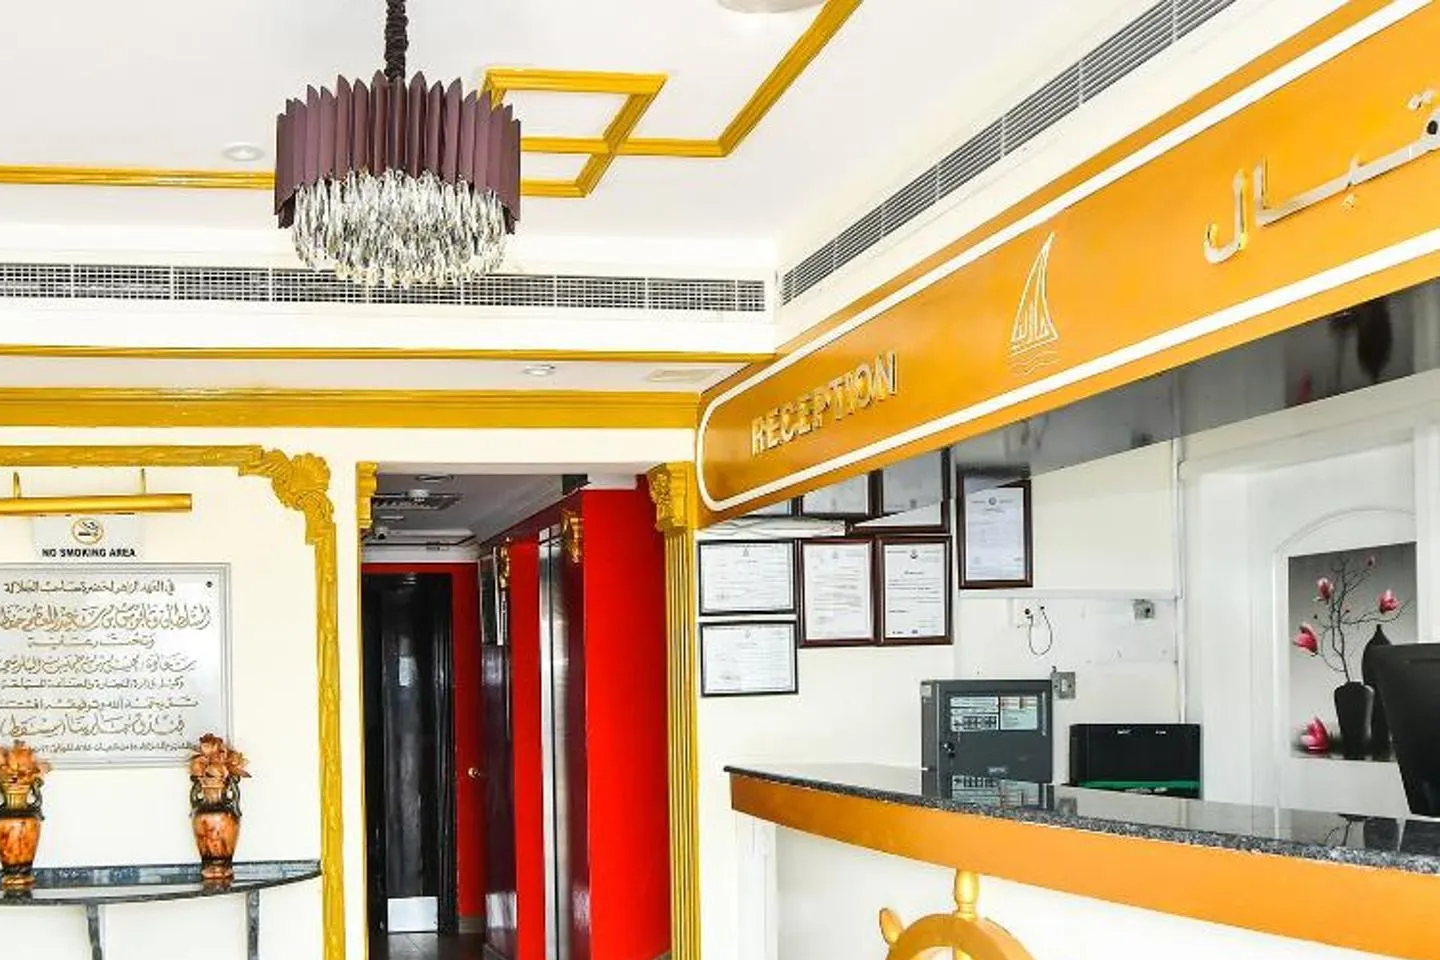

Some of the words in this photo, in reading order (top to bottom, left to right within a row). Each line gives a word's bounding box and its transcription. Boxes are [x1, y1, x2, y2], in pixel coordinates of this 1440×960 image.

[751, 350, 897, 456] RECEPTION
[42, 548, 57, 557] NO
[60, 548, 106, 557] SMOKING
[109, 548, 136, 557] AREA
